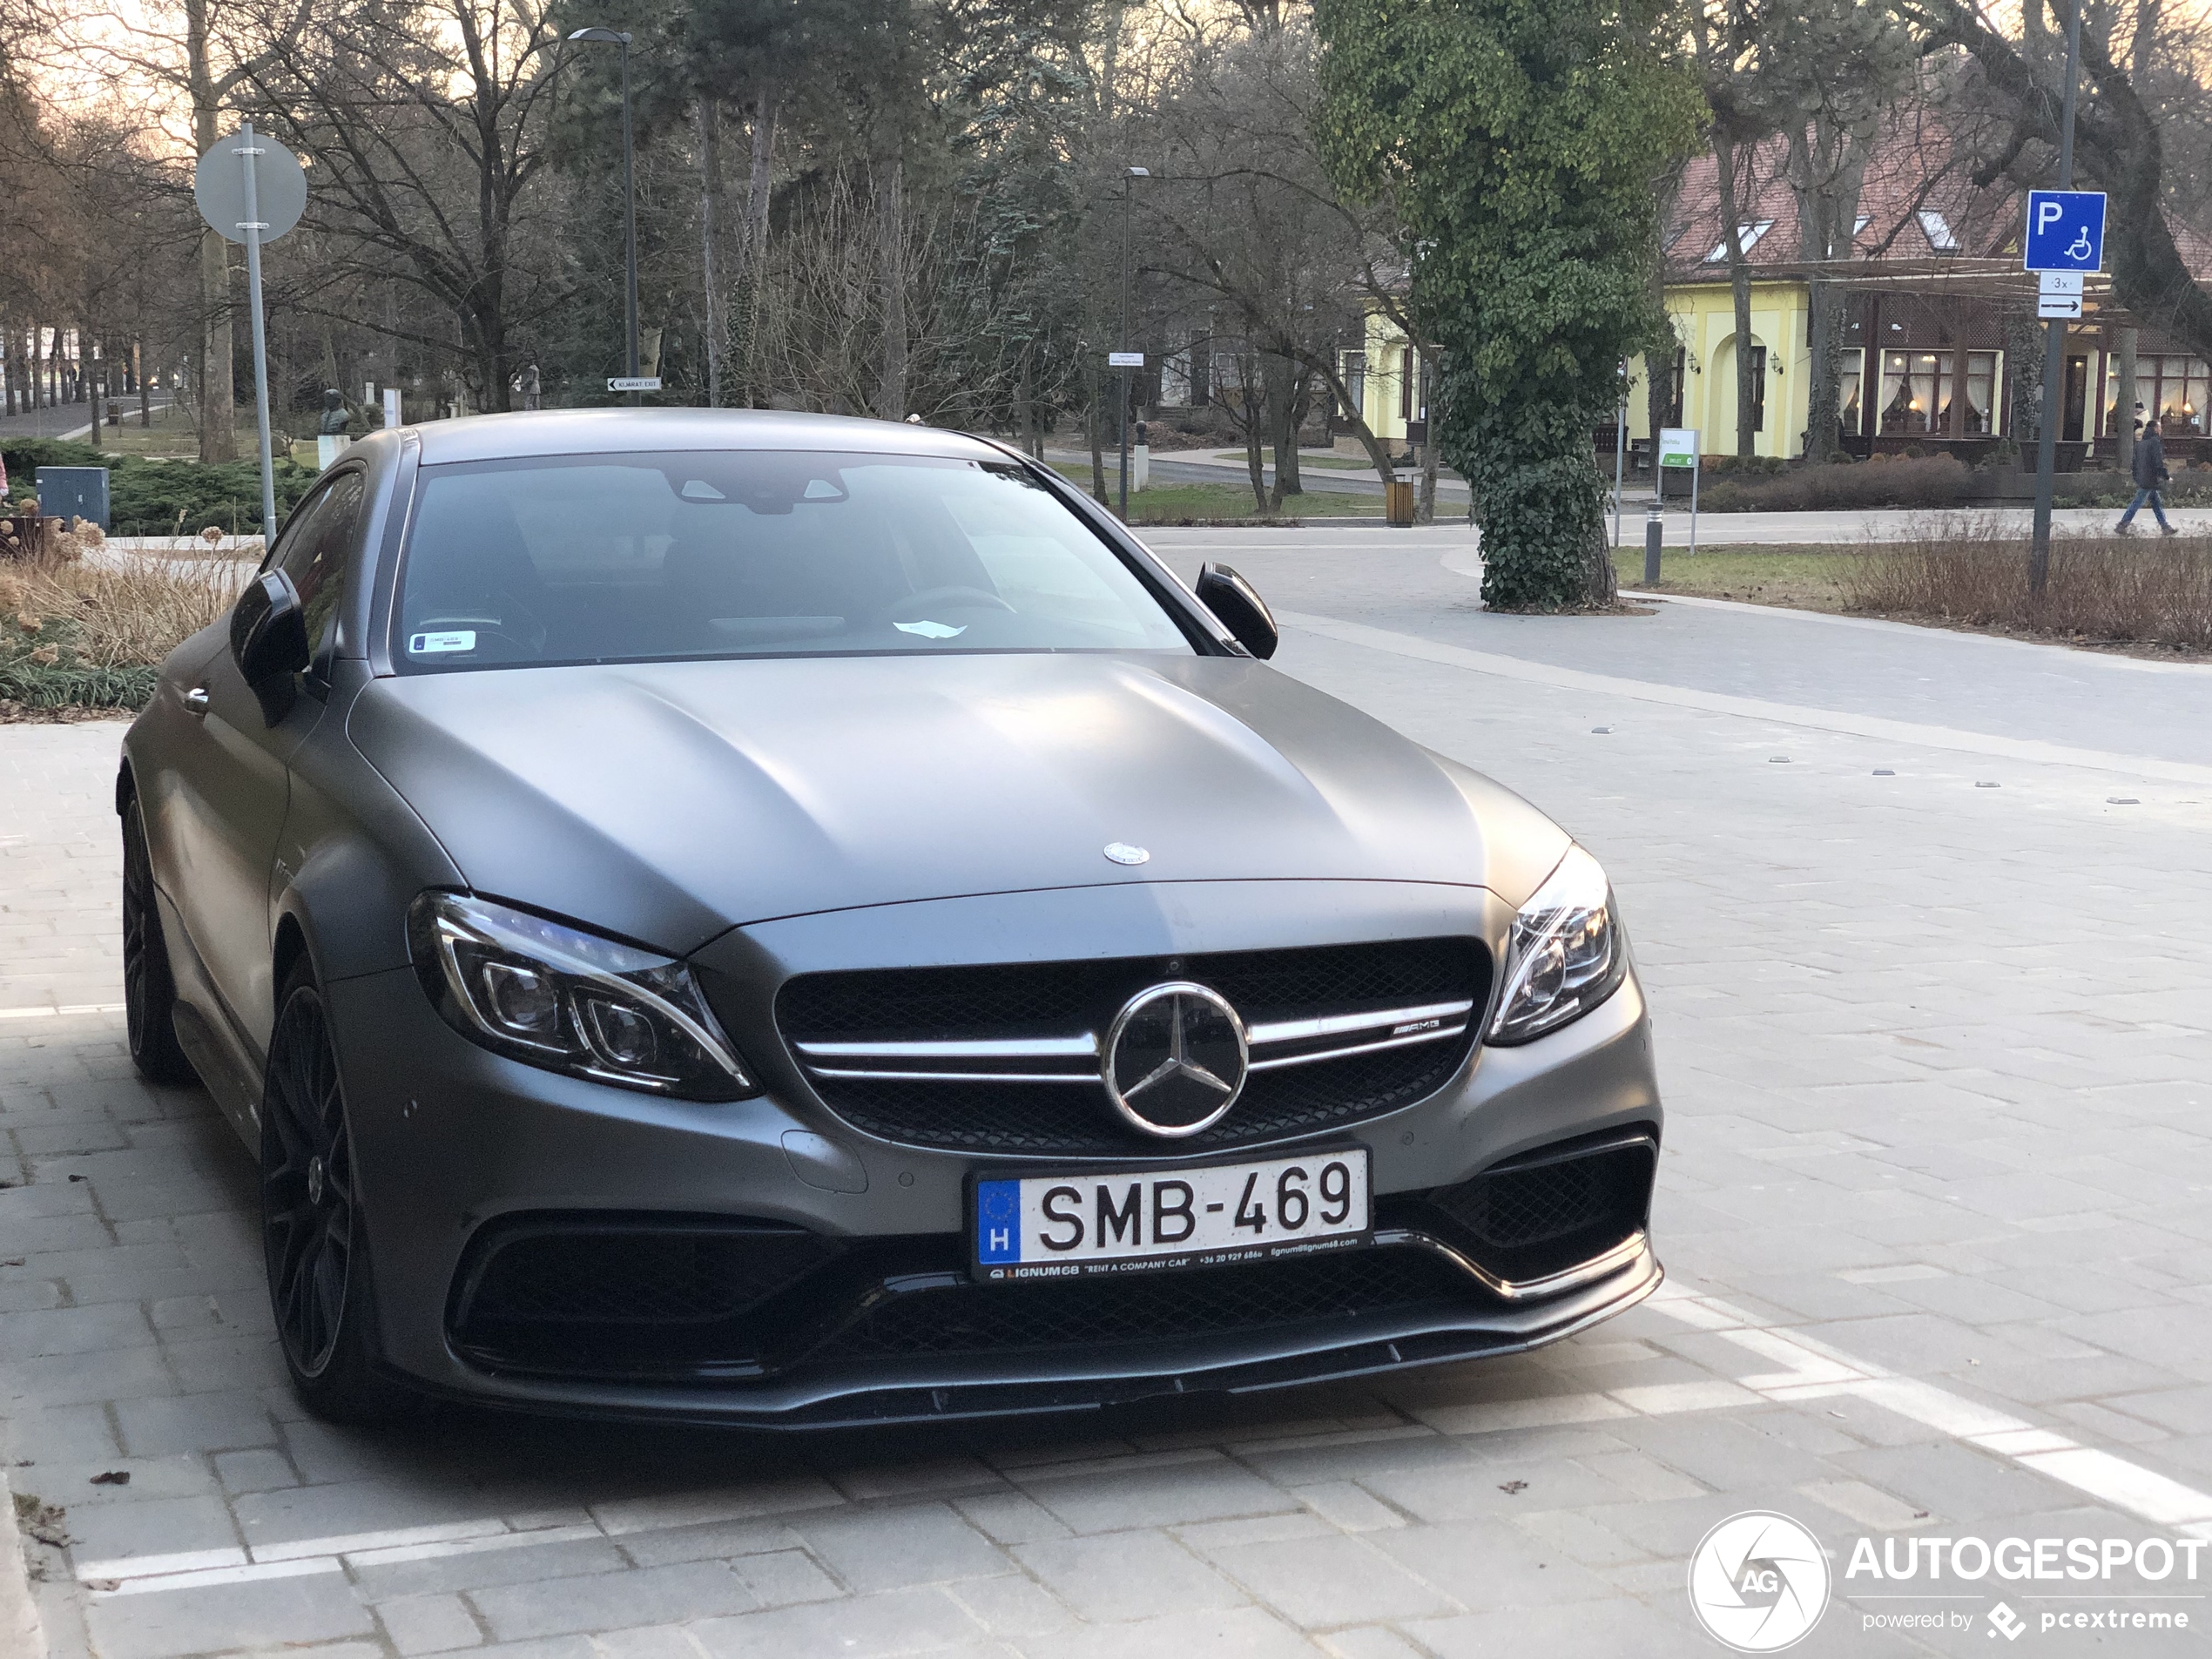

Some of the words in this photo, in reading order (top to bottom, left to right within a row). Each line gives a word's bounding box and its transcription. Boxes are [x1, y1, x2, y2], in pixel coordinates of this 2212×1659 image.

[2038, 202, 2063, 235] P
[1039, 1161, 1352, 1251] SMB-469
[990, 1228, 1008, 1251] H
[1007, 1264, 1080, 1278] LIGNUM68
[1119, 1259, 1164, 1271] COMPANY
